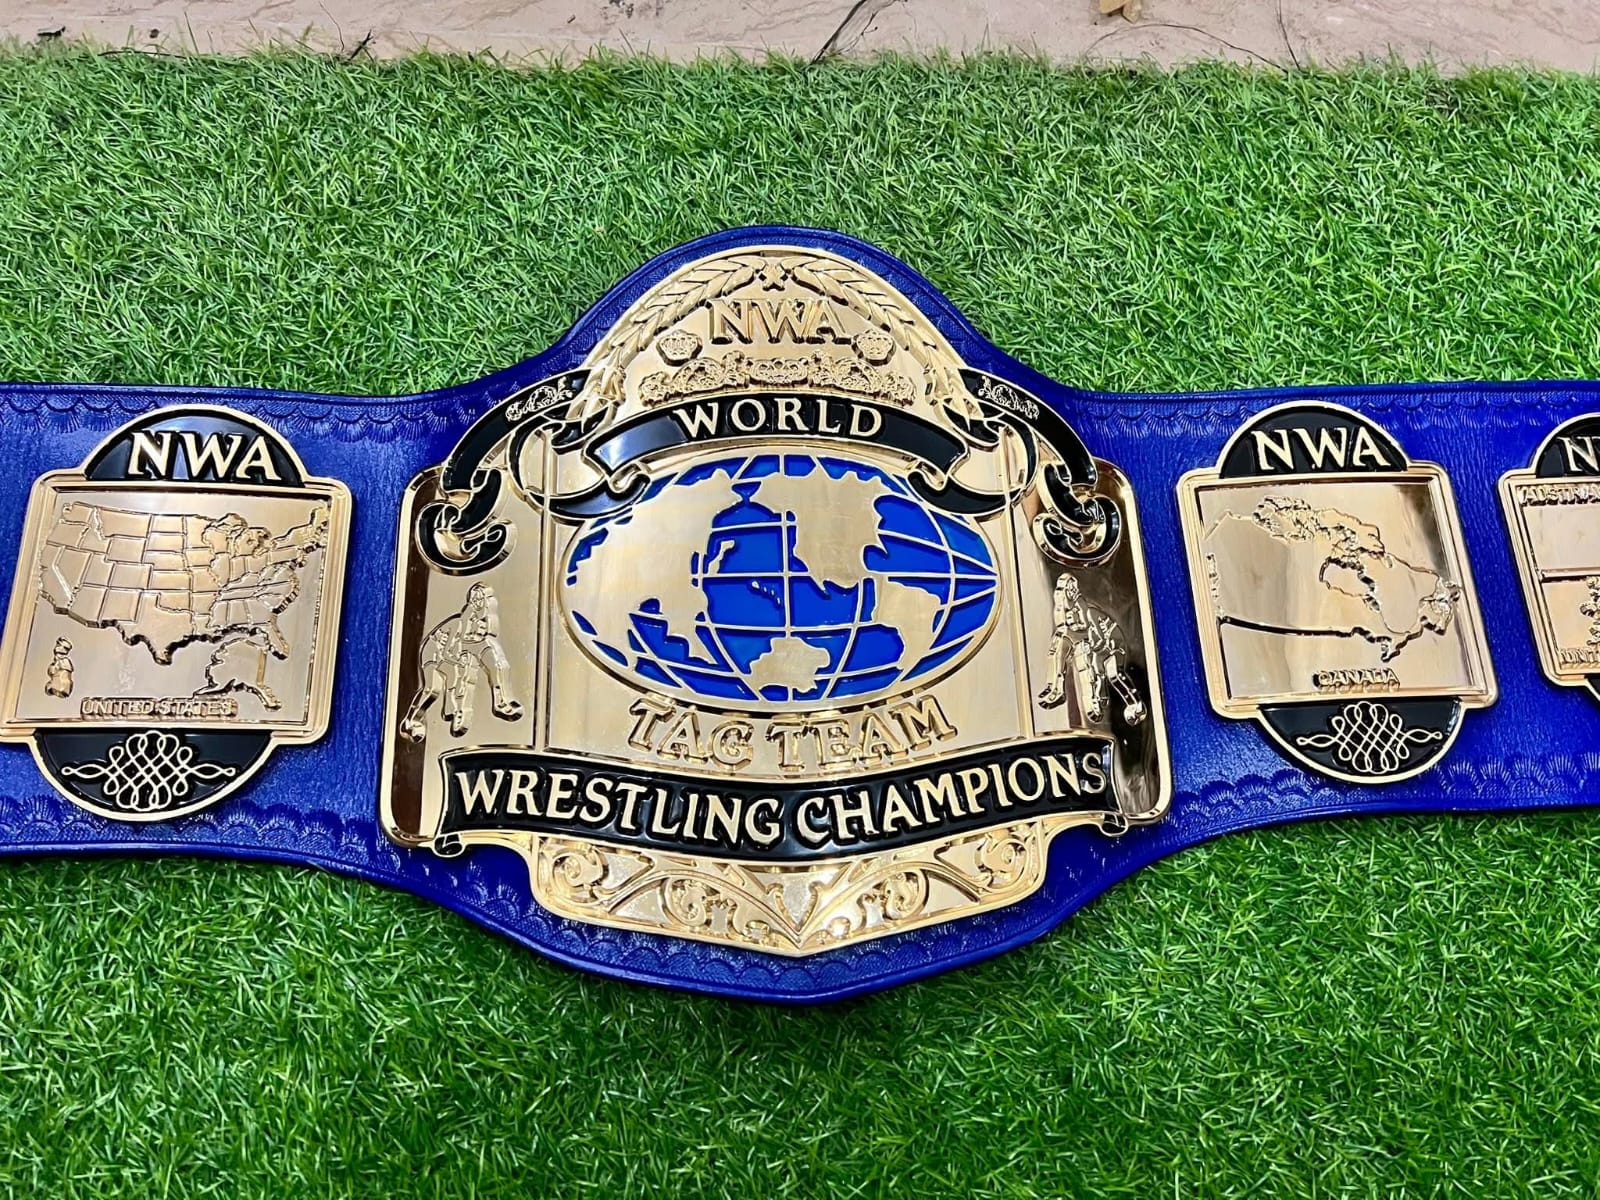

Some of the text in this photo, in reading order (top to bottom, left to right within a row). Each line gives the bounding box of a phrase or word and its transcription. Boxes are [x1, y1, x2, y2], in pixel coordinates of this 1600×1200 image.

[708, 299, 849, 344] NWA
[673, 398, 882, 439] WORLD
[129, 431, 282, 481] NWA
[1252, 427, 1390, 471] NWA
[1557, 436, 1600, 472] N
[1316, 667, 1400, 688] CANADA
[81, 698, 235, 717] UNITED STATES
[629, 695, 957, 771] TAG TEAM
[455, 753, 1106, 846] WRESTLING CHAMPIONS
